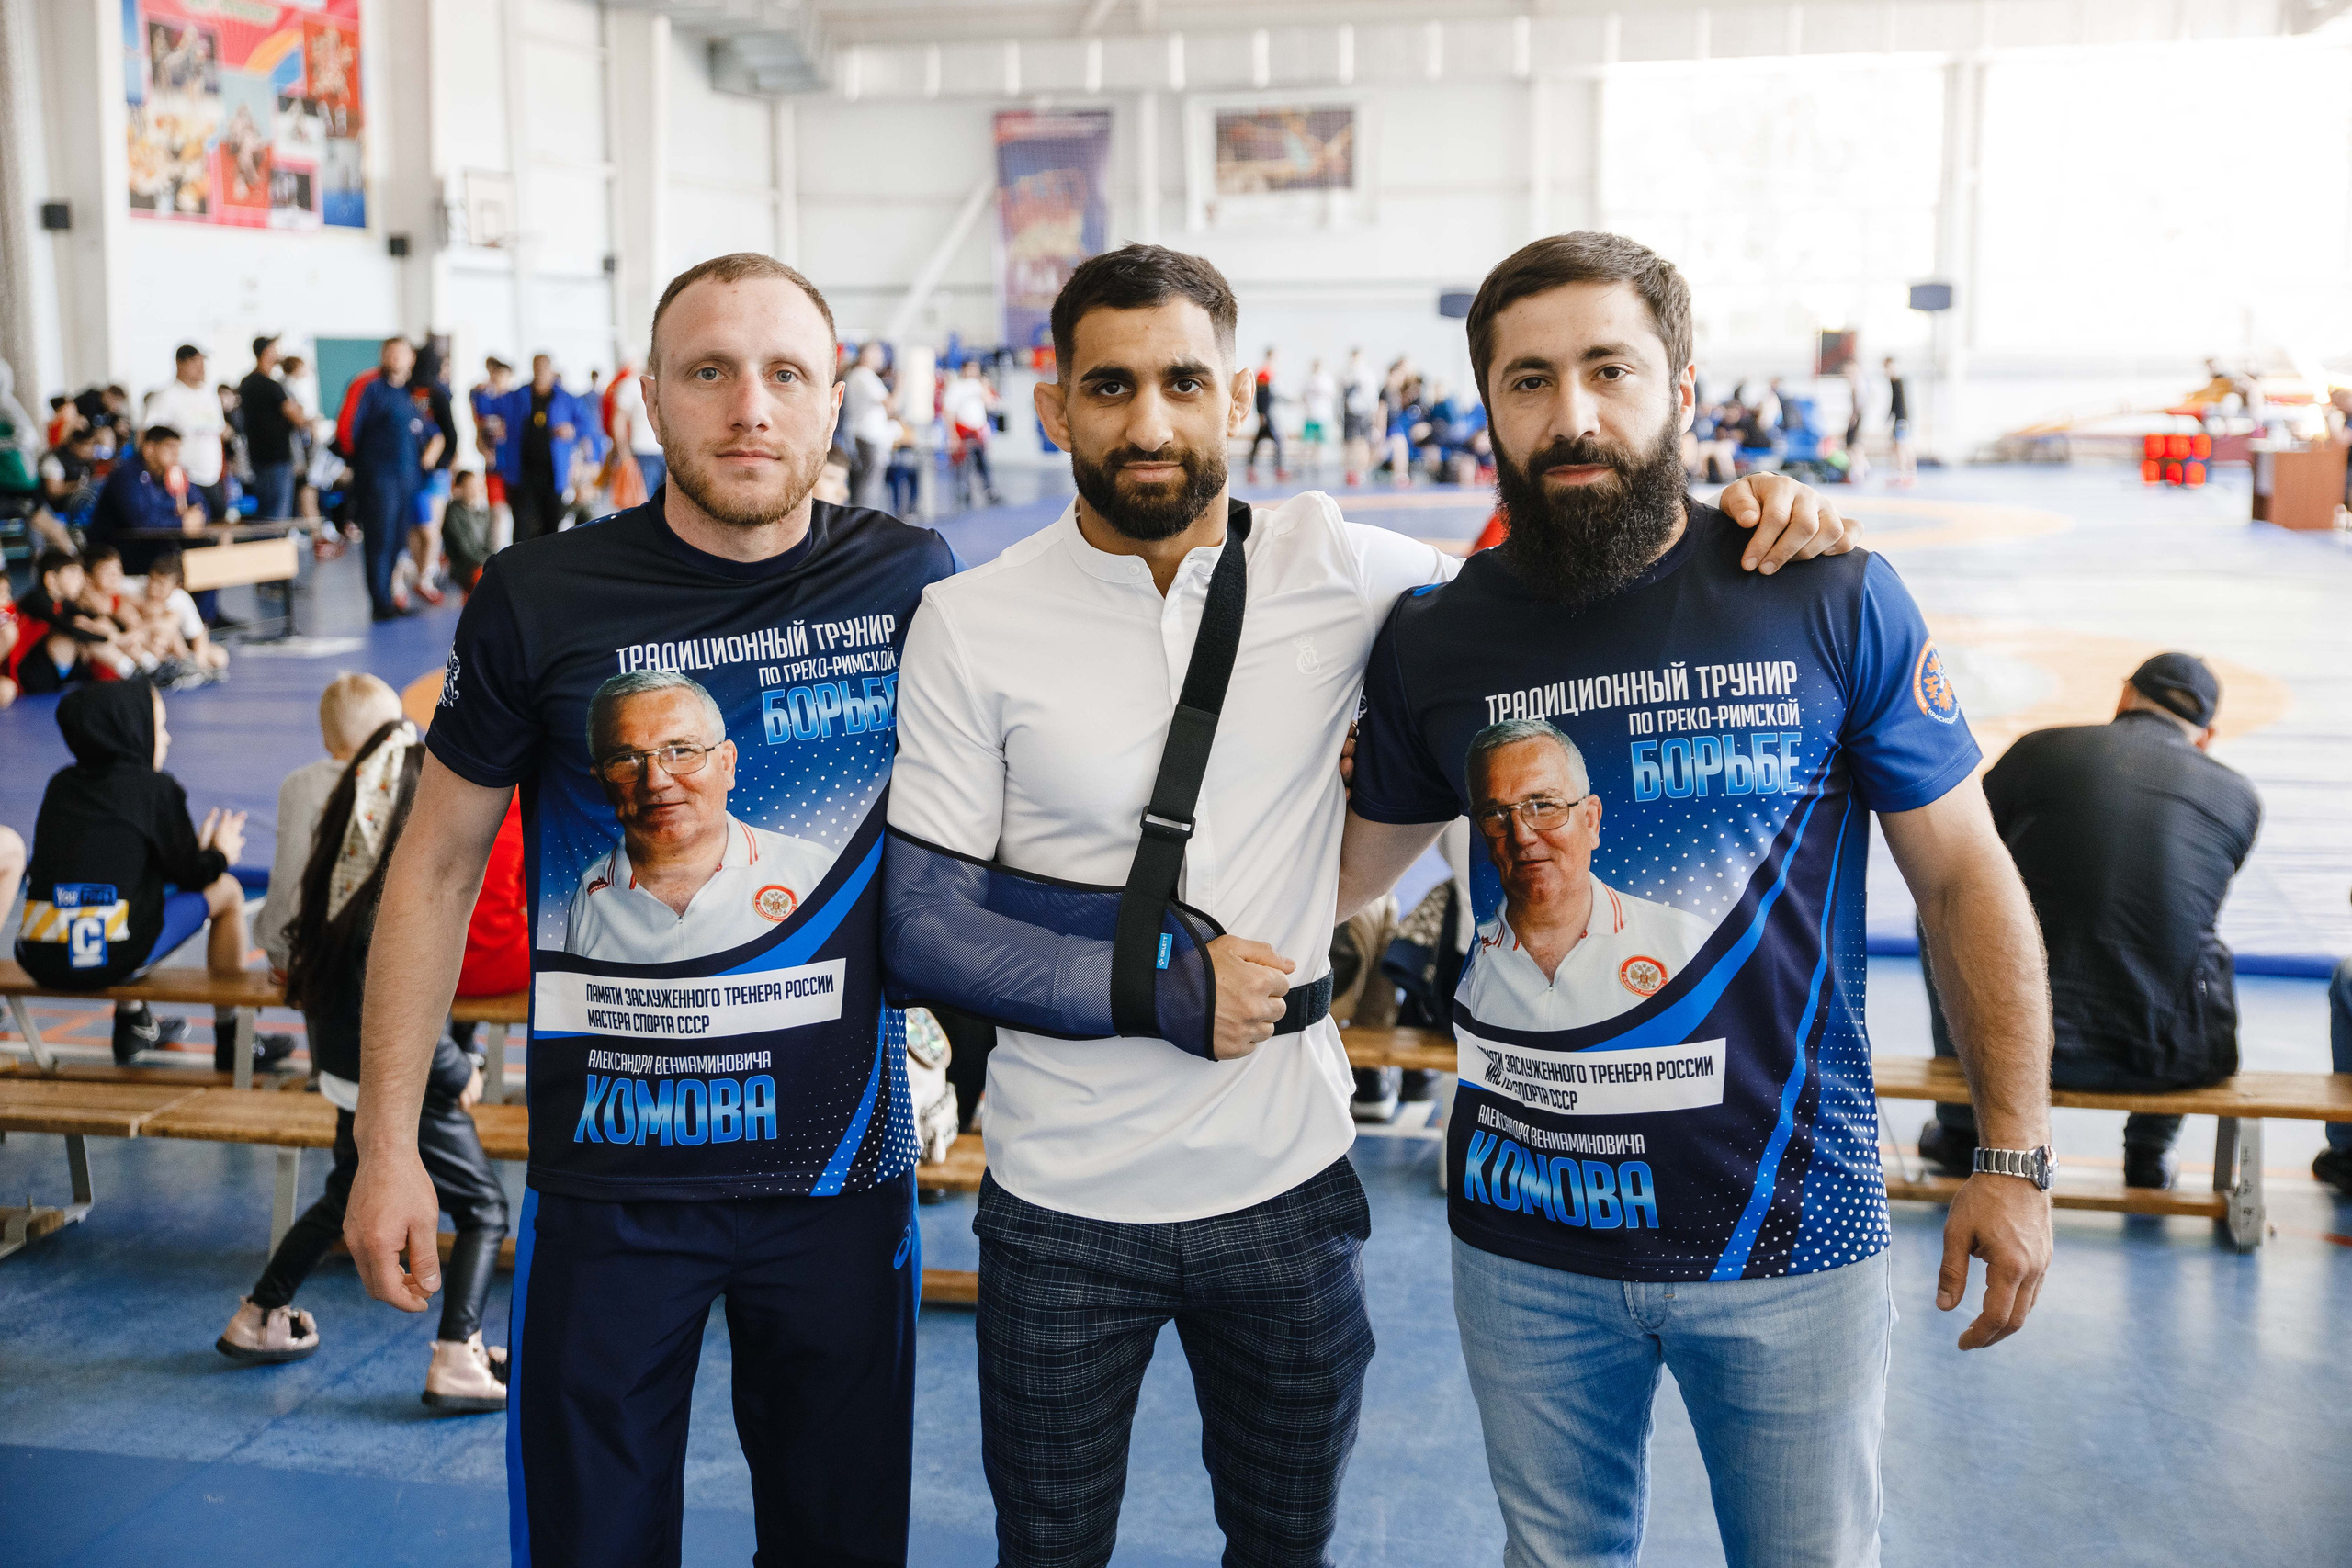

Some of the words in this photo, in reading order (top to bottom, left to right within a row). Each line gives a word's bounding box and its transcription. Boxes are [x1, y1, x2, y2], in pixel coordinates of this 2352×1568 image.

[616, 619, 809, 674] ТРАДИЦИОННЫЙ
[812, 614, 896, 650] ТРУНИР
[758, 666, 781, 687] ПО
[784, 647, 897, 682] ГРЕКО-РИМСКОЙ
[1485, 661, 1690, 726] ТРАДИЦИОННЫЙ
[1695, 660, 1798, 699] ТРУНИР
[1629, 712, 1654, 736] ПО
[1657, 698, 1801, 732] ГРЕКО-РИМСКОЙ
[1630, 732, 1802, 802] БОРЬБЕ
[586, 983, 624, 1006] ПАМЯТИ
[625, 987, 720, 1009] ЗАСЛУЖЕННОГО
[724, 982, 782, 1006] ТРЕНЕРА
[786, 974, 834, 999] РОССИИ
[588, 1009, 631, 1032] МАСТЕРА
[633, 1013, 675, 1033] СПОРТА
[677, 1015, 710, 1033] СССР
[588, 1049, 653, 1076] АЛЕКСАНДРА
[655, 1050, 772, 1075] ВЕНИАМИНОВИЧА
[1505, 1054, 1587, 1083] ЗАСЛУЖЕННОГО
[1589, 1062, 1653, 1084] ТРЕНЕРА
[1657, 1055, 1714, 1081] РОССИИ
[573, 1074, 778, 1147] КОМОВА
[1550, 1088, 1578, 1111] СССР
[1531, 1126, 1646, 1155] ВЕНИАМИНОВИЧА
[1464, 1129, 1660, 1230] КОМОВА
